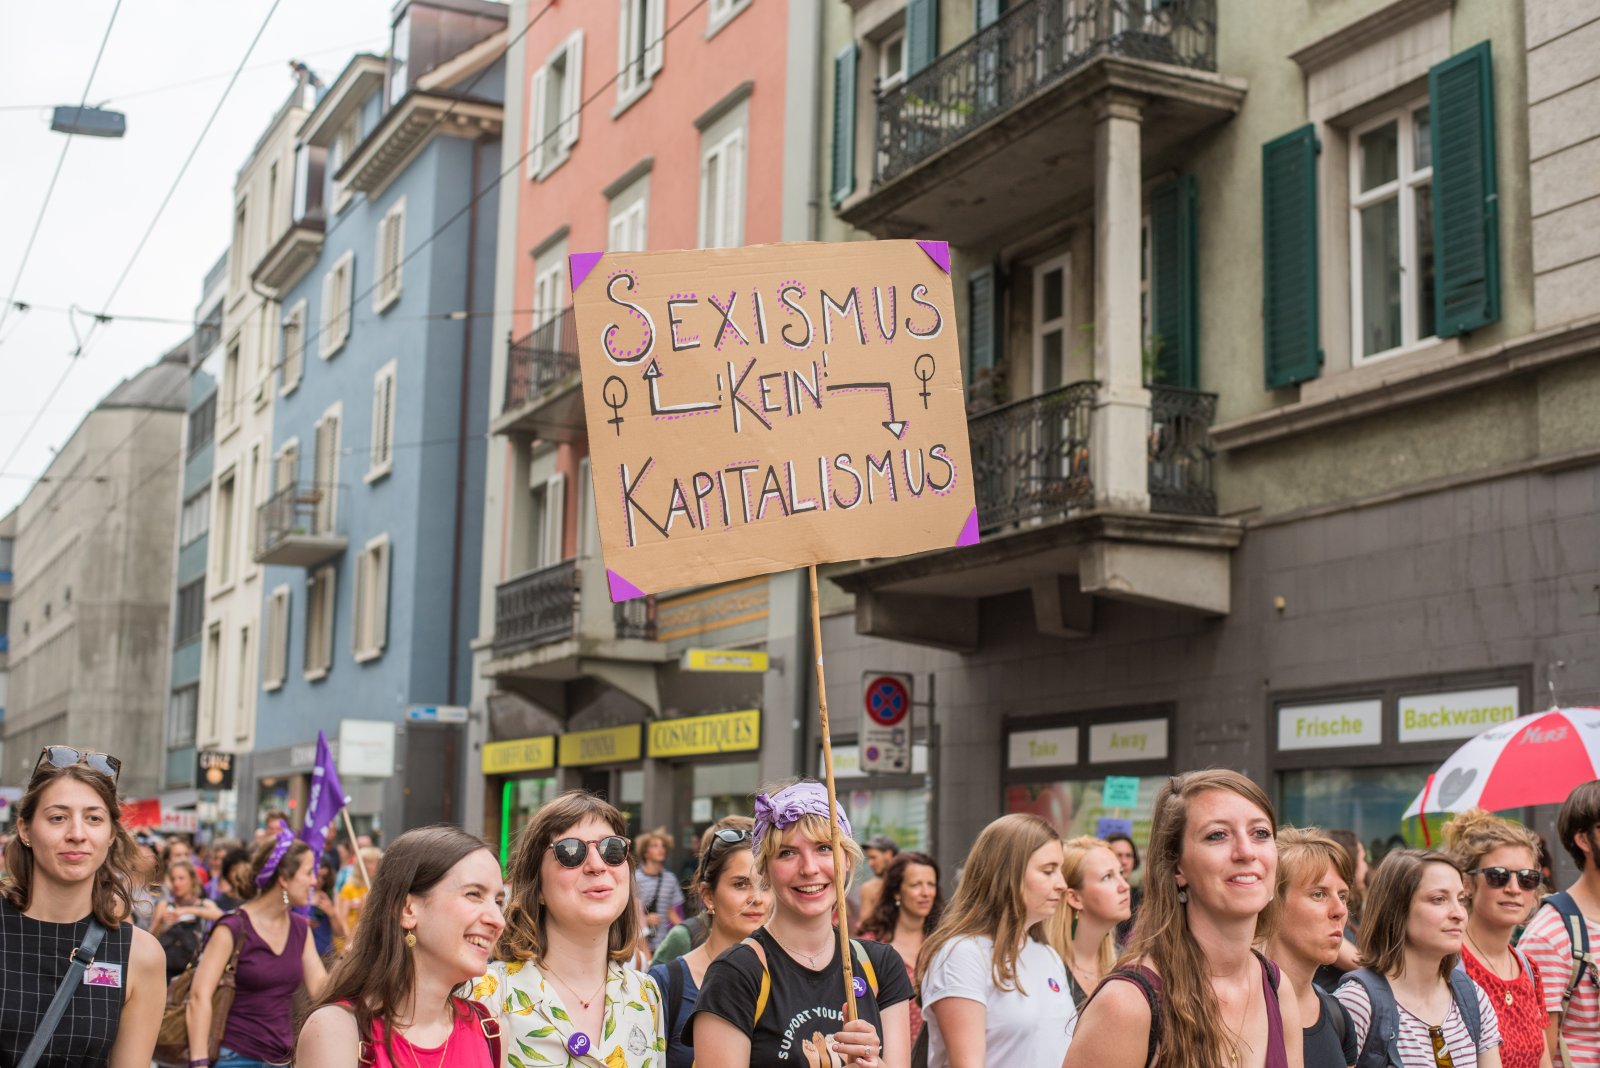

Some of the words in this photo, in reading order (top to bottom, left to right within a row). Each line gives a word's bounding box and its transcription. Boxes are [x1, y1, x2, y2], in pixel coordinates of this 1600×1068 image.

[601, 271, 944, 366] SEXISMUS
[618, 444, 957, 547] KAPITALISMUS
[653, 716, 754, 751] COSMETIQUES
[1296, 714, 1362, 737] Frische
[1404, 704, 1514, 731] Backwaren
[1028, 739, 1058, 758] Take
[1109, 731, 1147, 751] Away
[778, 1009, 812, 1060] SUPPORT
